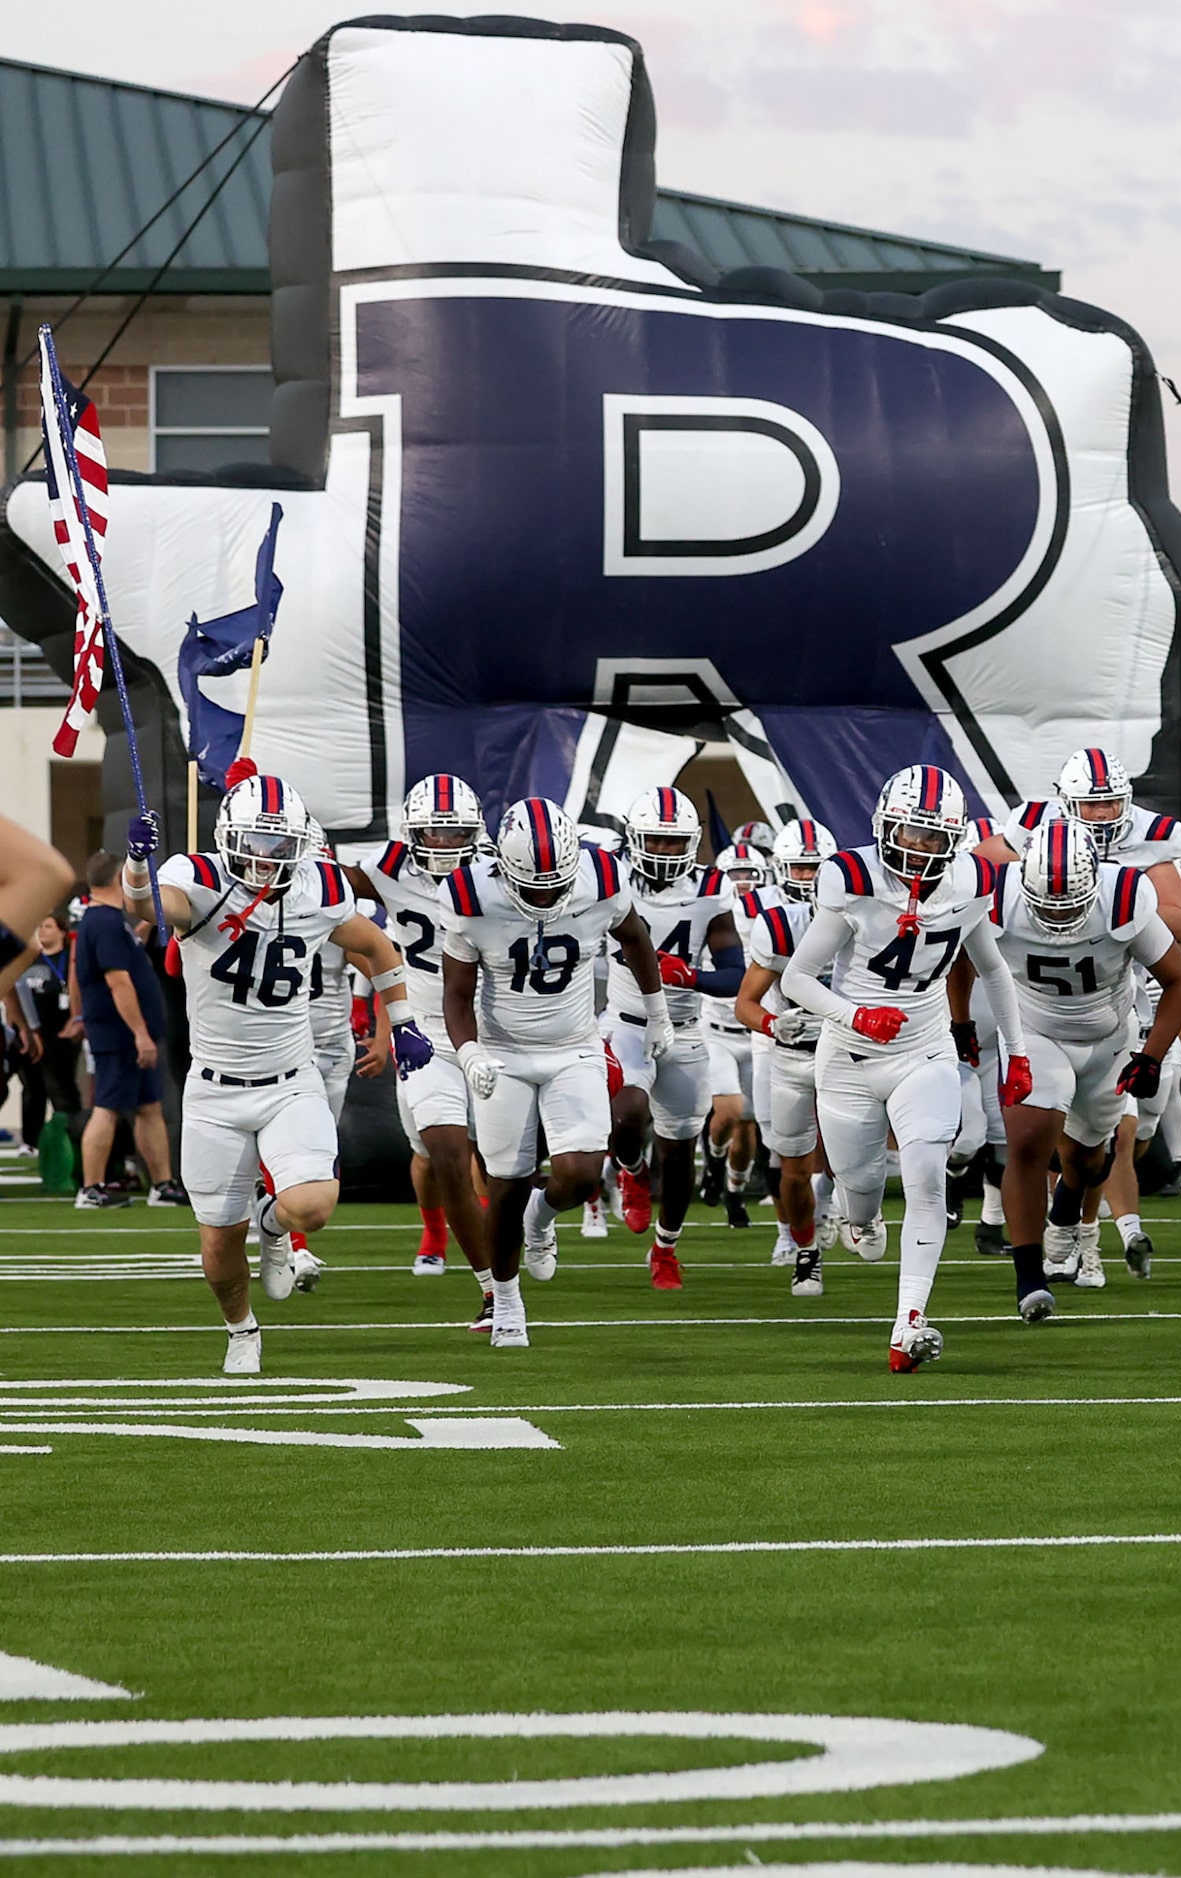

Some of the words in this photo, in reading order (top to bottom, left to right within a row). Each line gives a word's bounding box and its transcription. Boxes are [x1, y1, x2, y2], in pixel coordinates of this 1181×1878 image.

[335, 263, 1072, 850] R
[210, 930, 307, 1007] 46
[396, 908, 446, 974] 2
[868, 928, 962, 991] 47
[1027, 954, 1098, 997] 51
